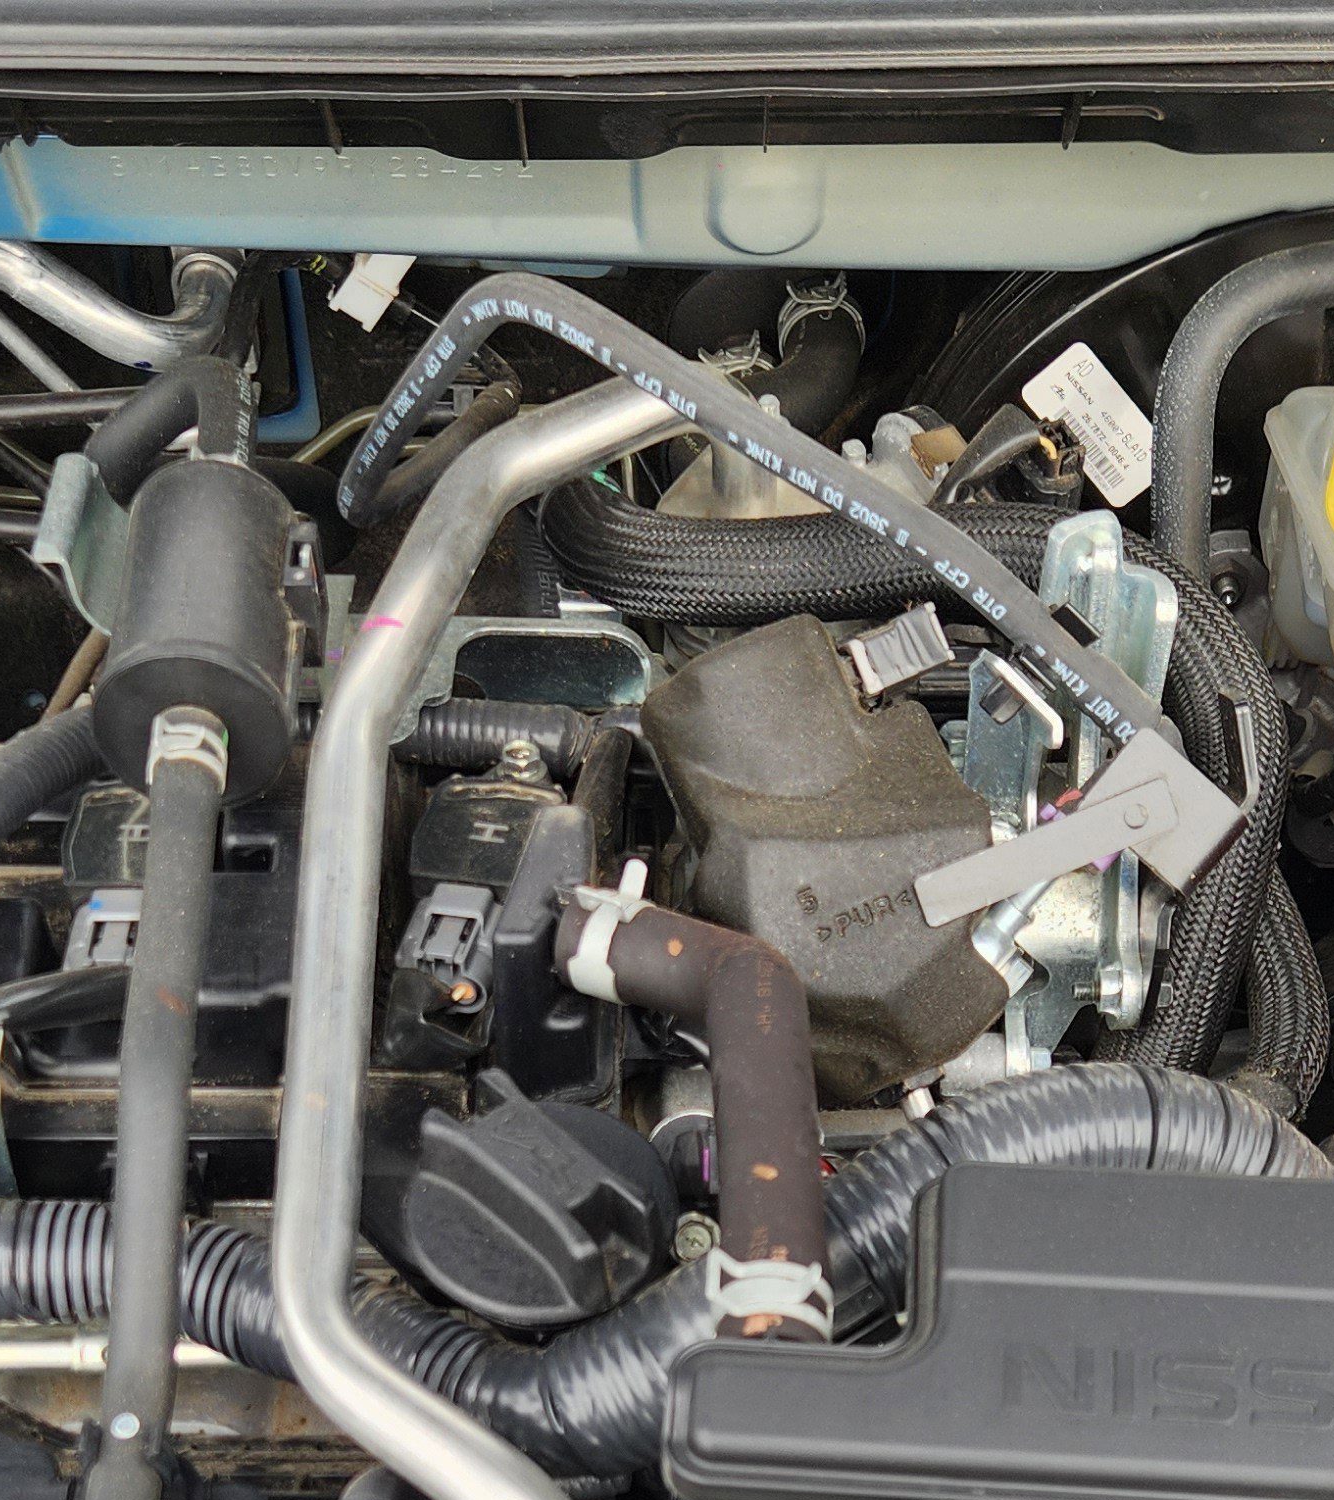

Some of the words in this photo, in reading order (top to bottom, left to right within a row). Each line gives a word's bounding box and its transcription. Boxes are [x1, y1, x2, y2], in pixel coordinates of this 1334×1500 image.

[1073, 358, 1094, 377] AD
[1065, 372, 1094, 405] NISSAN
[745, 442, 782, 475] KINK
[788, 467, 820, 497] NOT
[822, 485, 846, 506] DO
[934, 559, 970, 589] CFP
[974, 587, 1008, 621] DTR
[1049, 660, 1089, 698] KINK
[1084, 691, 1123, 728] NOT
